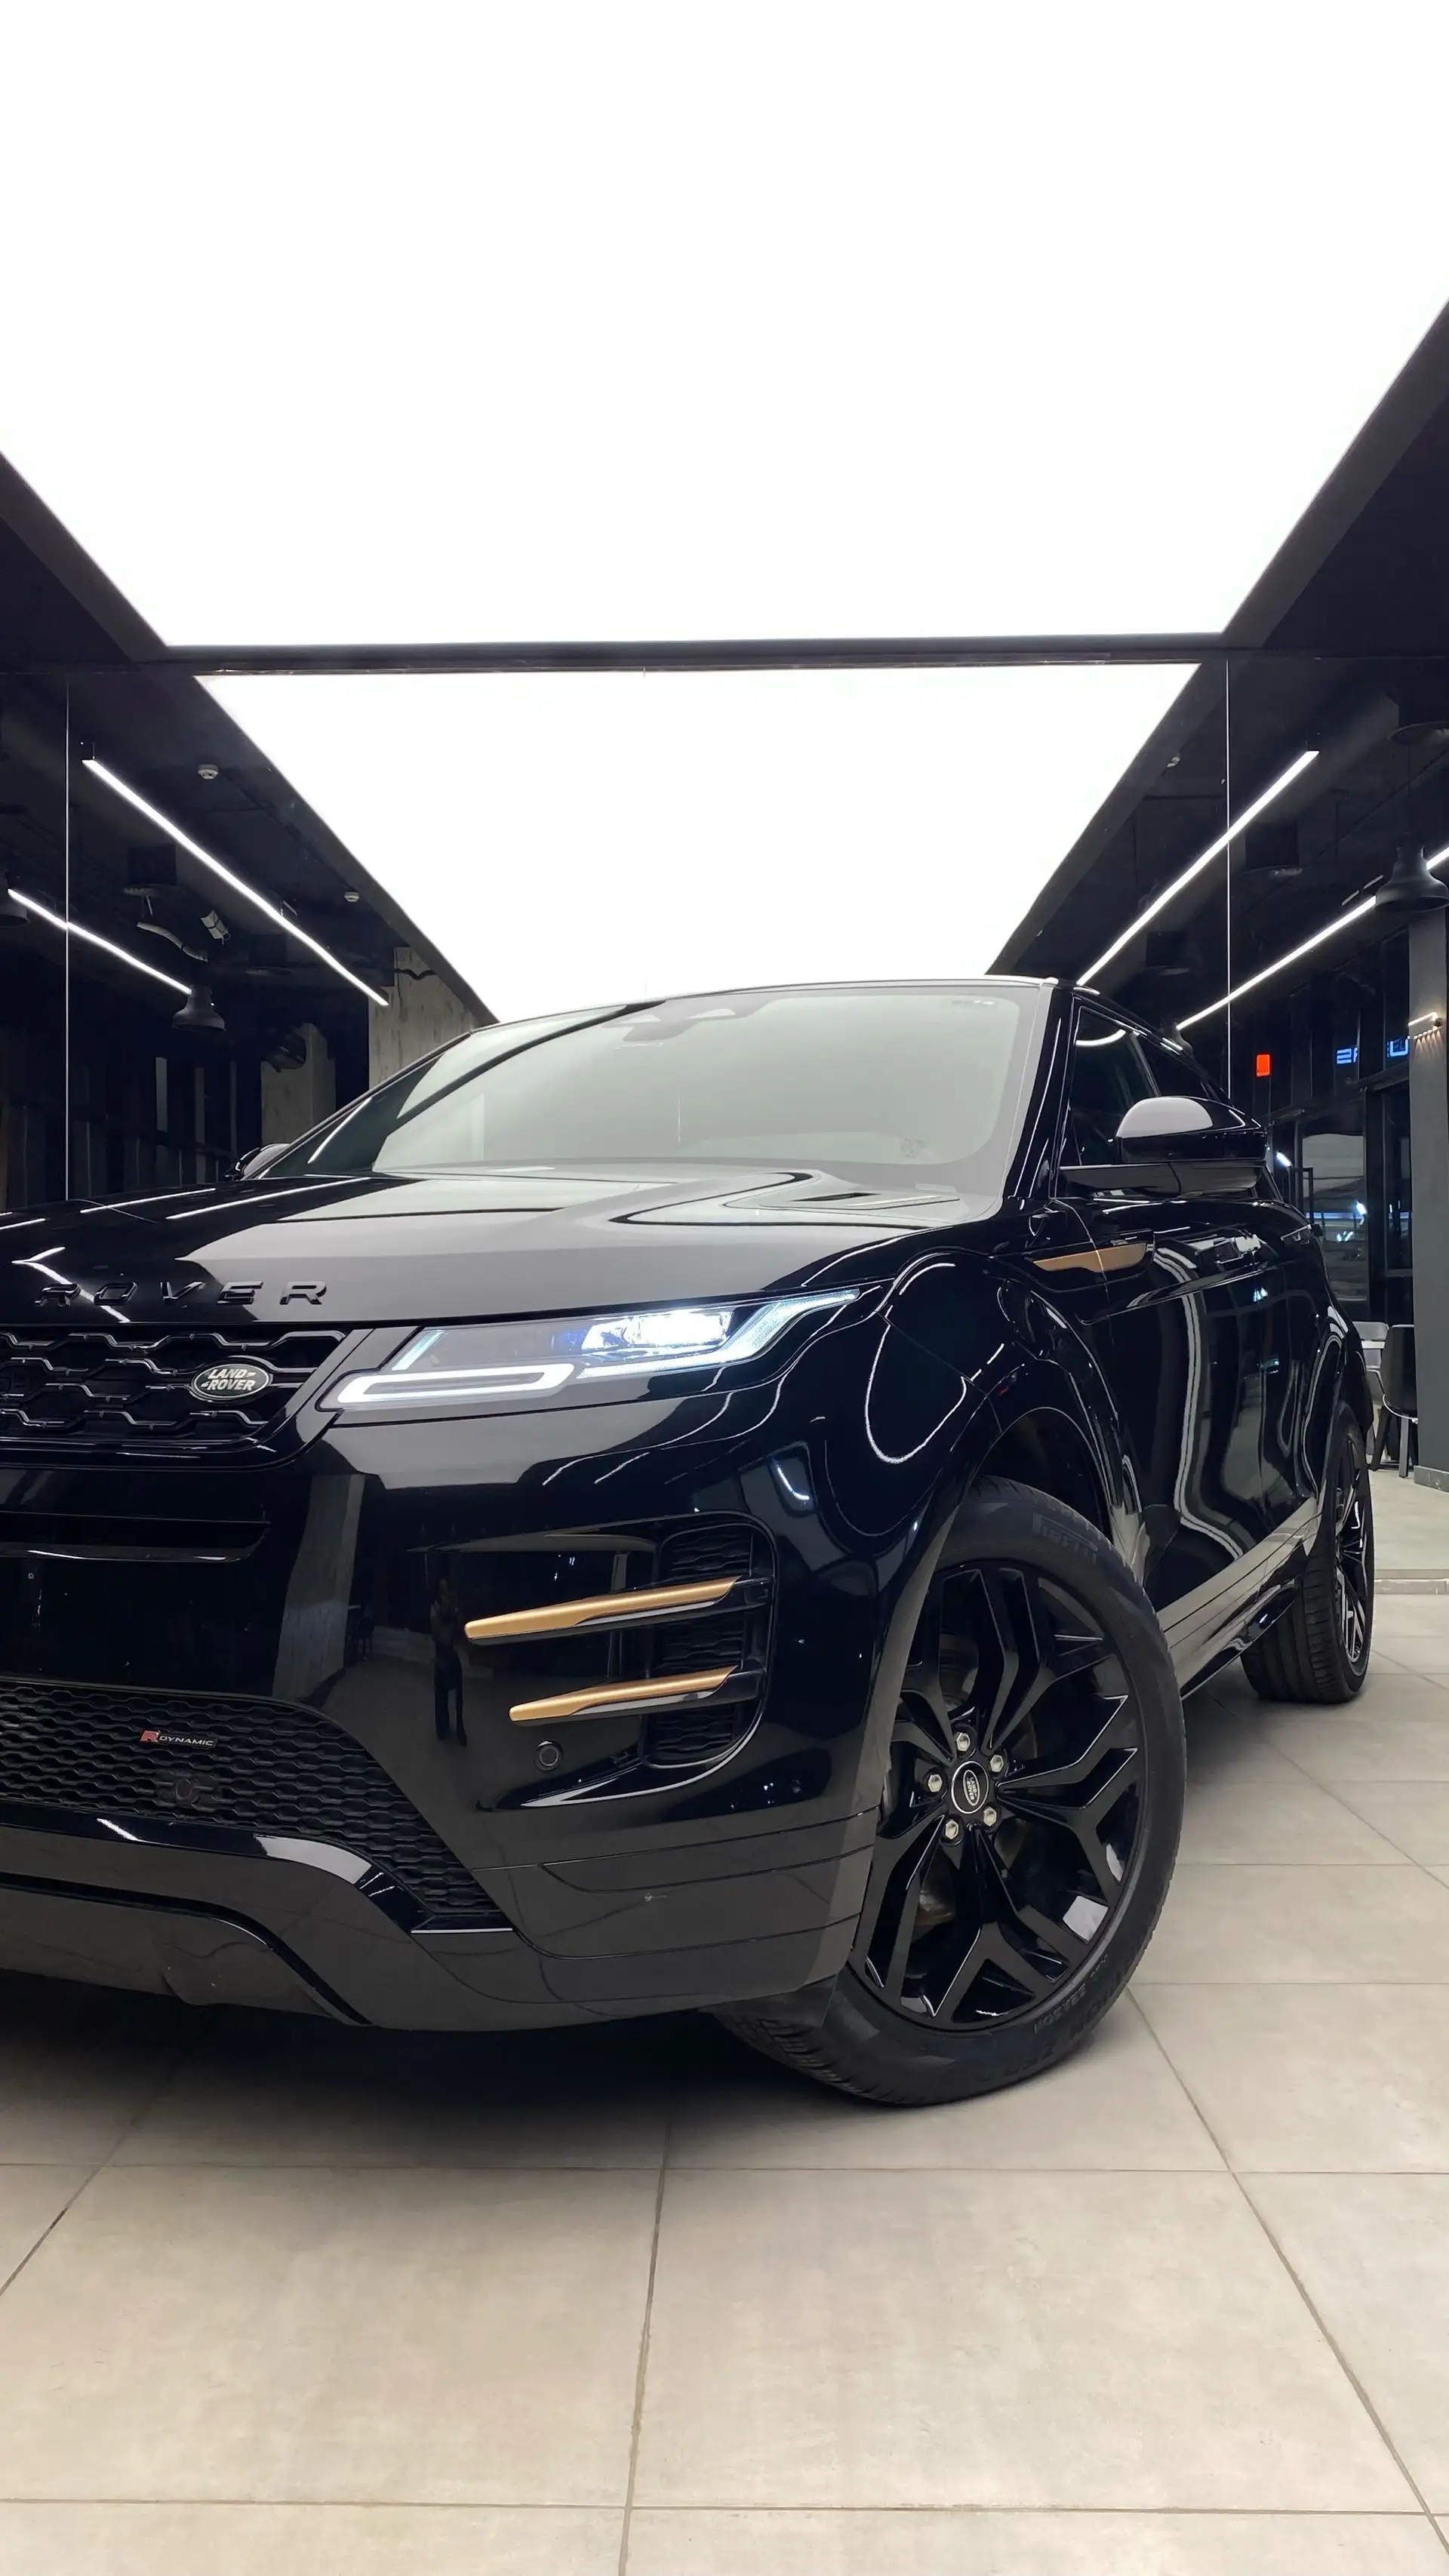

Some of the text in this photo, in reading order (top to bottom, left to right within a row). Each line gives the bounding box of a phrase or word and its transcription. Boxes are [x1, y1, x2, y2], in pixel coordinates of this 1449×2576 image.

[34, 1280, 327, 1306] ROVER
[208, 1368, 248, 1380] LAND
[206, 1379, 257, 1391] ROVER
[159, 1735, 215, 1747] DYNAMIC
